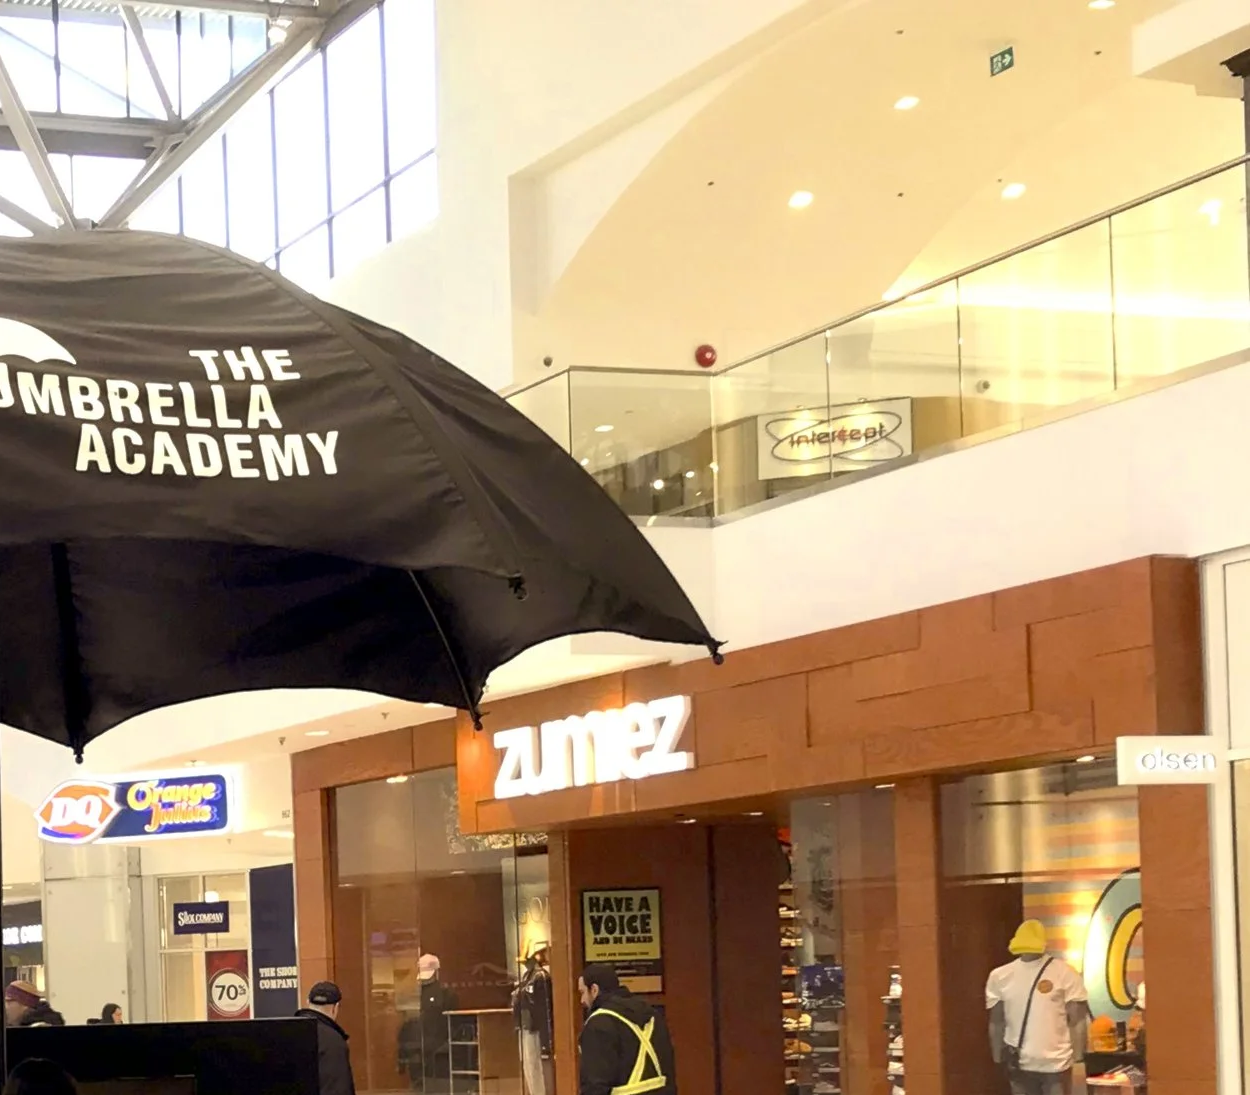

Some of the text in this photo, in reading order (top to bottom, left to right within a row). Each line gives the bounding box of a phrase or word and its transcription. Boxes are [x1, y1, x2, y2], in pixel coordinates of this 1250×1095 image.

[188, 346, 301, 381] THE
[76, 424, 339, 481] ACADEMY
[1140, 748, 1217, 771] olsen
[127, 780, 218, 811] Orange
[50, 794, 103, 829] DQ
[589, 896, 651, 912] HAVE A
[589, 913, 652, 935] VOICE
[259, 967, 276, 978] THE
